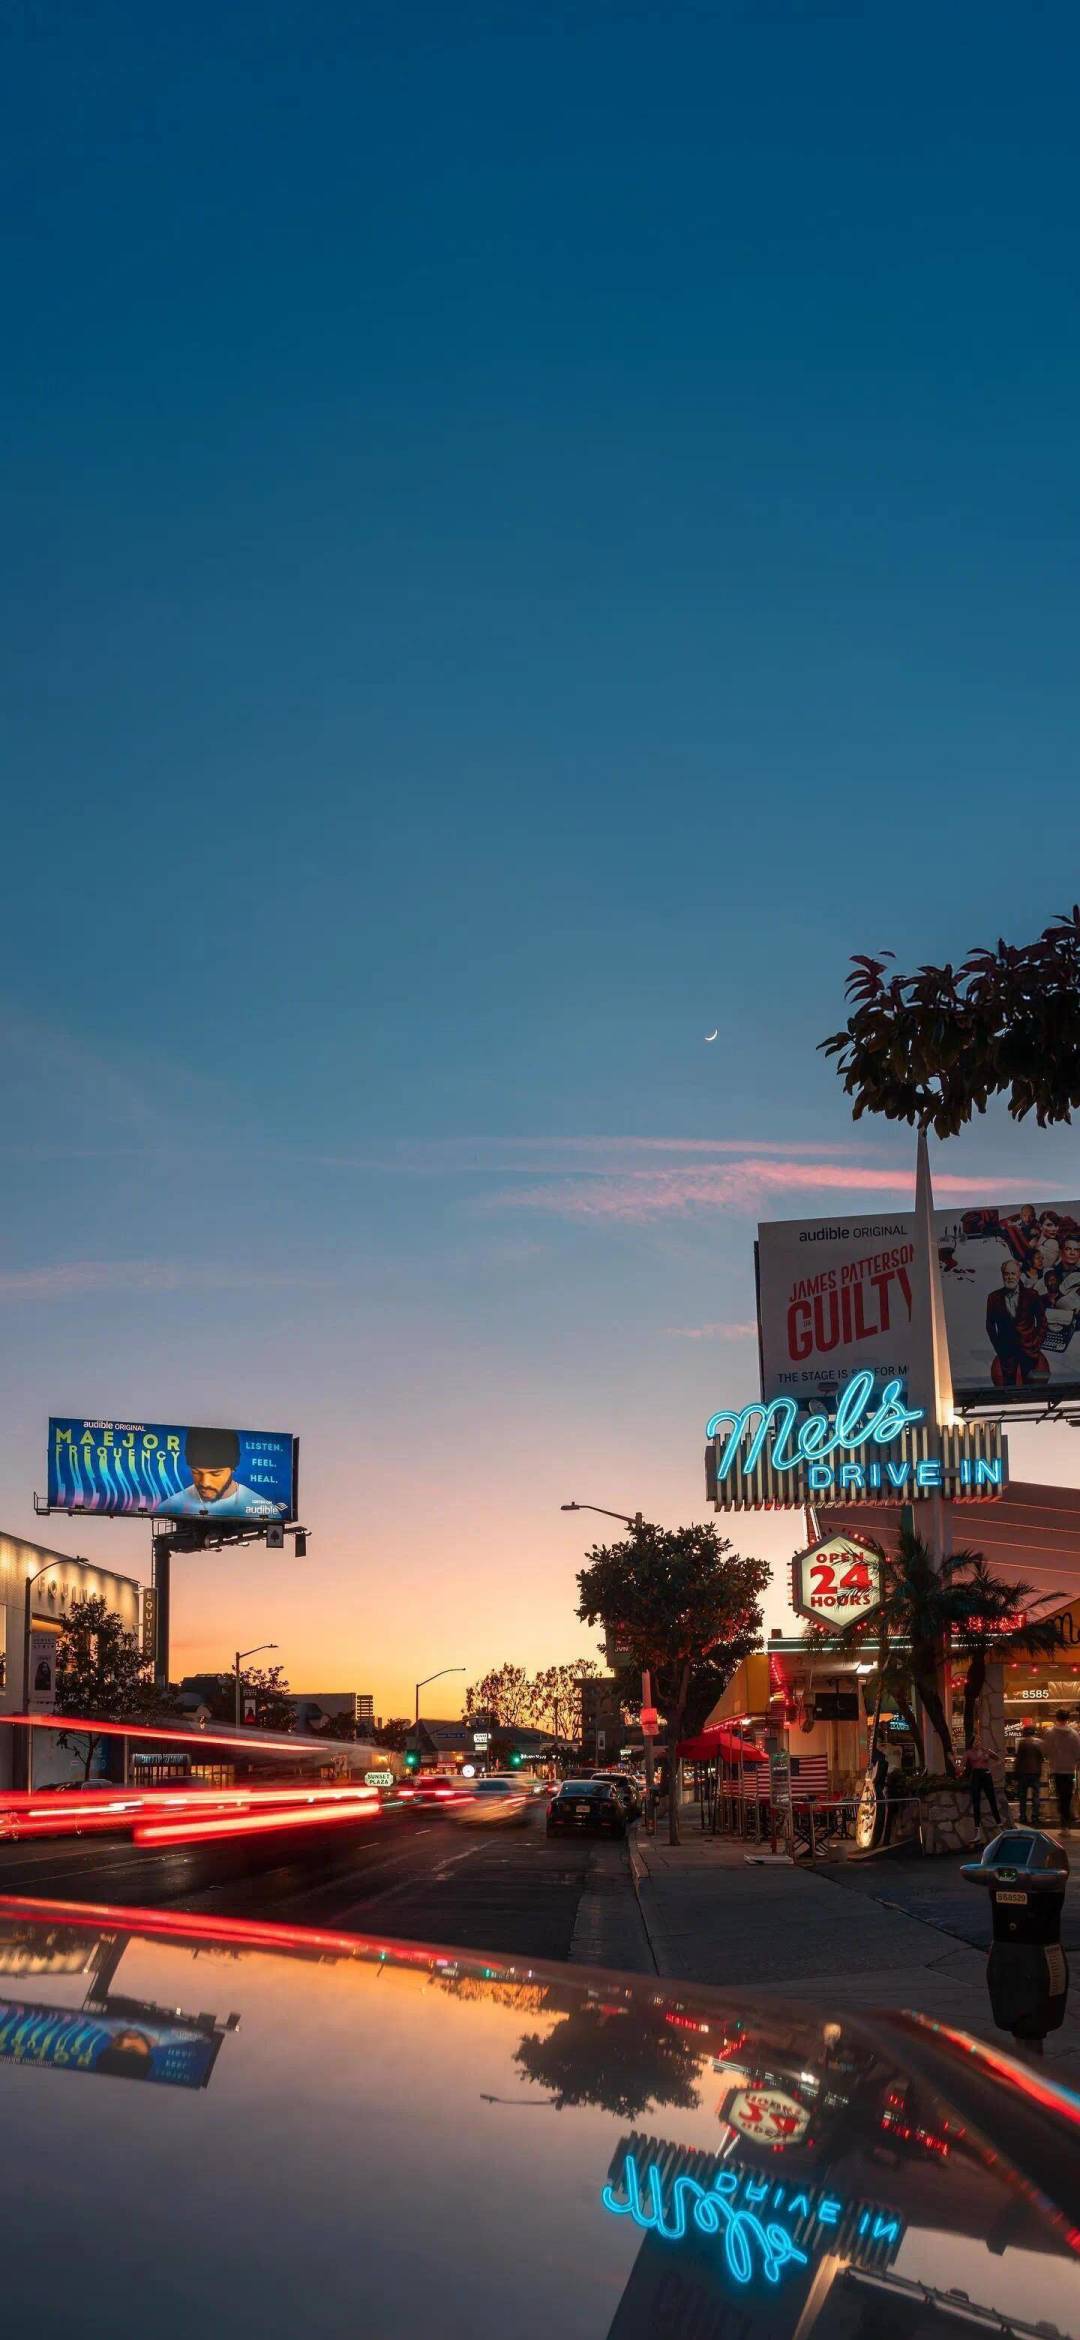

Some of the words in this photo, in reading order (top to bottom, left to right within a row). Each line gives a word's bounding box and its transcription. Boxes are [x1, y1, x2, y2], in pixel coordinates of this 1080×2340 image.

[799, 1226, 850, 1242] audible
[853, 1225, 908, 1239] ORIGINAL
[789, 1269, 837, 1302] JAMES
[778, 1373, 799, 1383] THE
[802, 1370, 835, 1382] STAGE
[838, 1369, 848, 1379] IS
[875, 1366, 895, 1377] FOR
[898, 1365, 909, 1375] M
[83, 1420, 113, 1430] audible
[114, 1424, 146, 1432] ORIGINAL
[706, 1370, 923, 1480] Mels
[56, 1428, 180, 1451] MAEJOR
[245, 1441, 284, 1452] LISTEN.
[251, 1458, 277, 1468] FEEL.
[250, 1474, 278, 1484] HEAL.
[808, 1460, 942, 1490] DRIVE
[960, 1457, 1001, 1485] IN
[245, 1504, 278, 1514] audible
[816, 1552, 865, 1564] OPEN
[810, 1563, 873, 1596] 24
[810, 1595, 871, 1608] HOURS
[145, 1592, 153, 1657] EQUINOX
[1022, 1689, 1050, 1699] 8585
